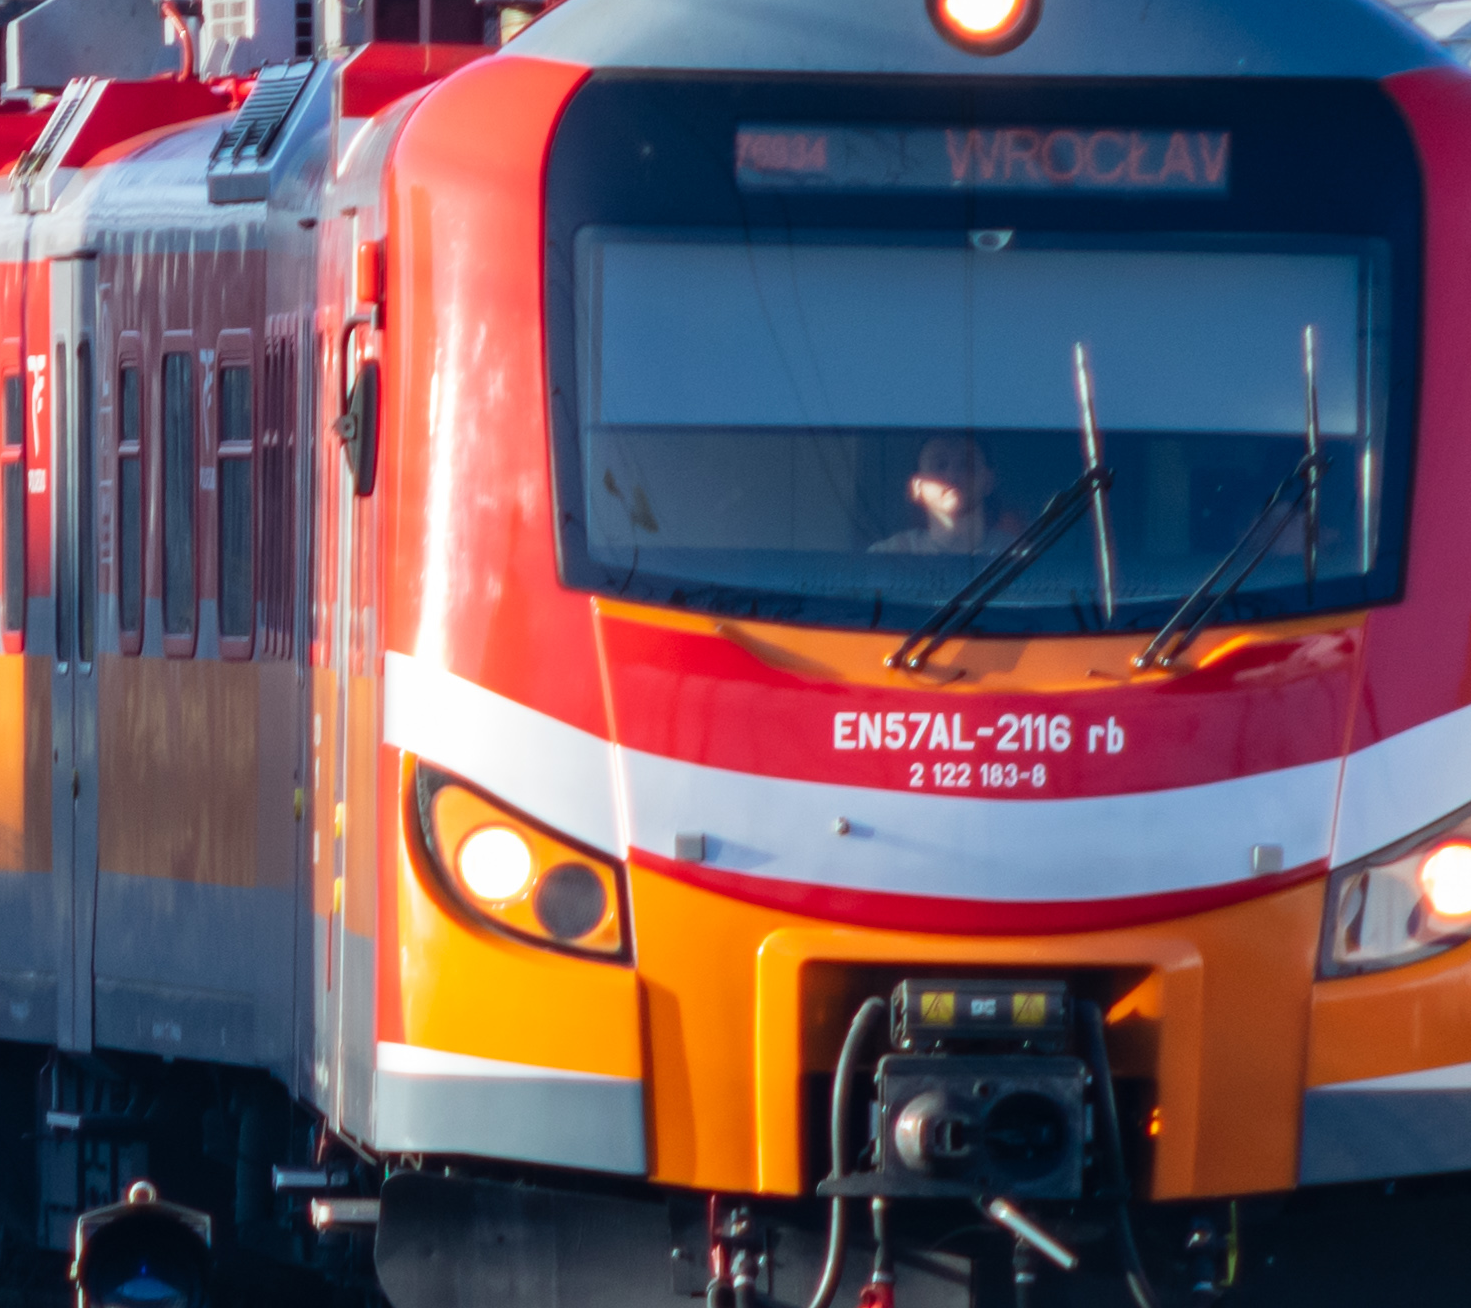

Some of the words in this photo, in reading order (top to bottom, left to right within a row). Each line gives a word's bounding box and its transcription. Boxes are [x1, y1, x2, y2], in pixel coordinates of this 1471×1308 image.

[833, 711, 1072, 752] EN57AL-2116
[1088, 716, 1125, 754] rb
[909, 762, 925, 788] 2
[933, 762, 972, 788] 122
[980, 762, 1047, 789] 183-8
